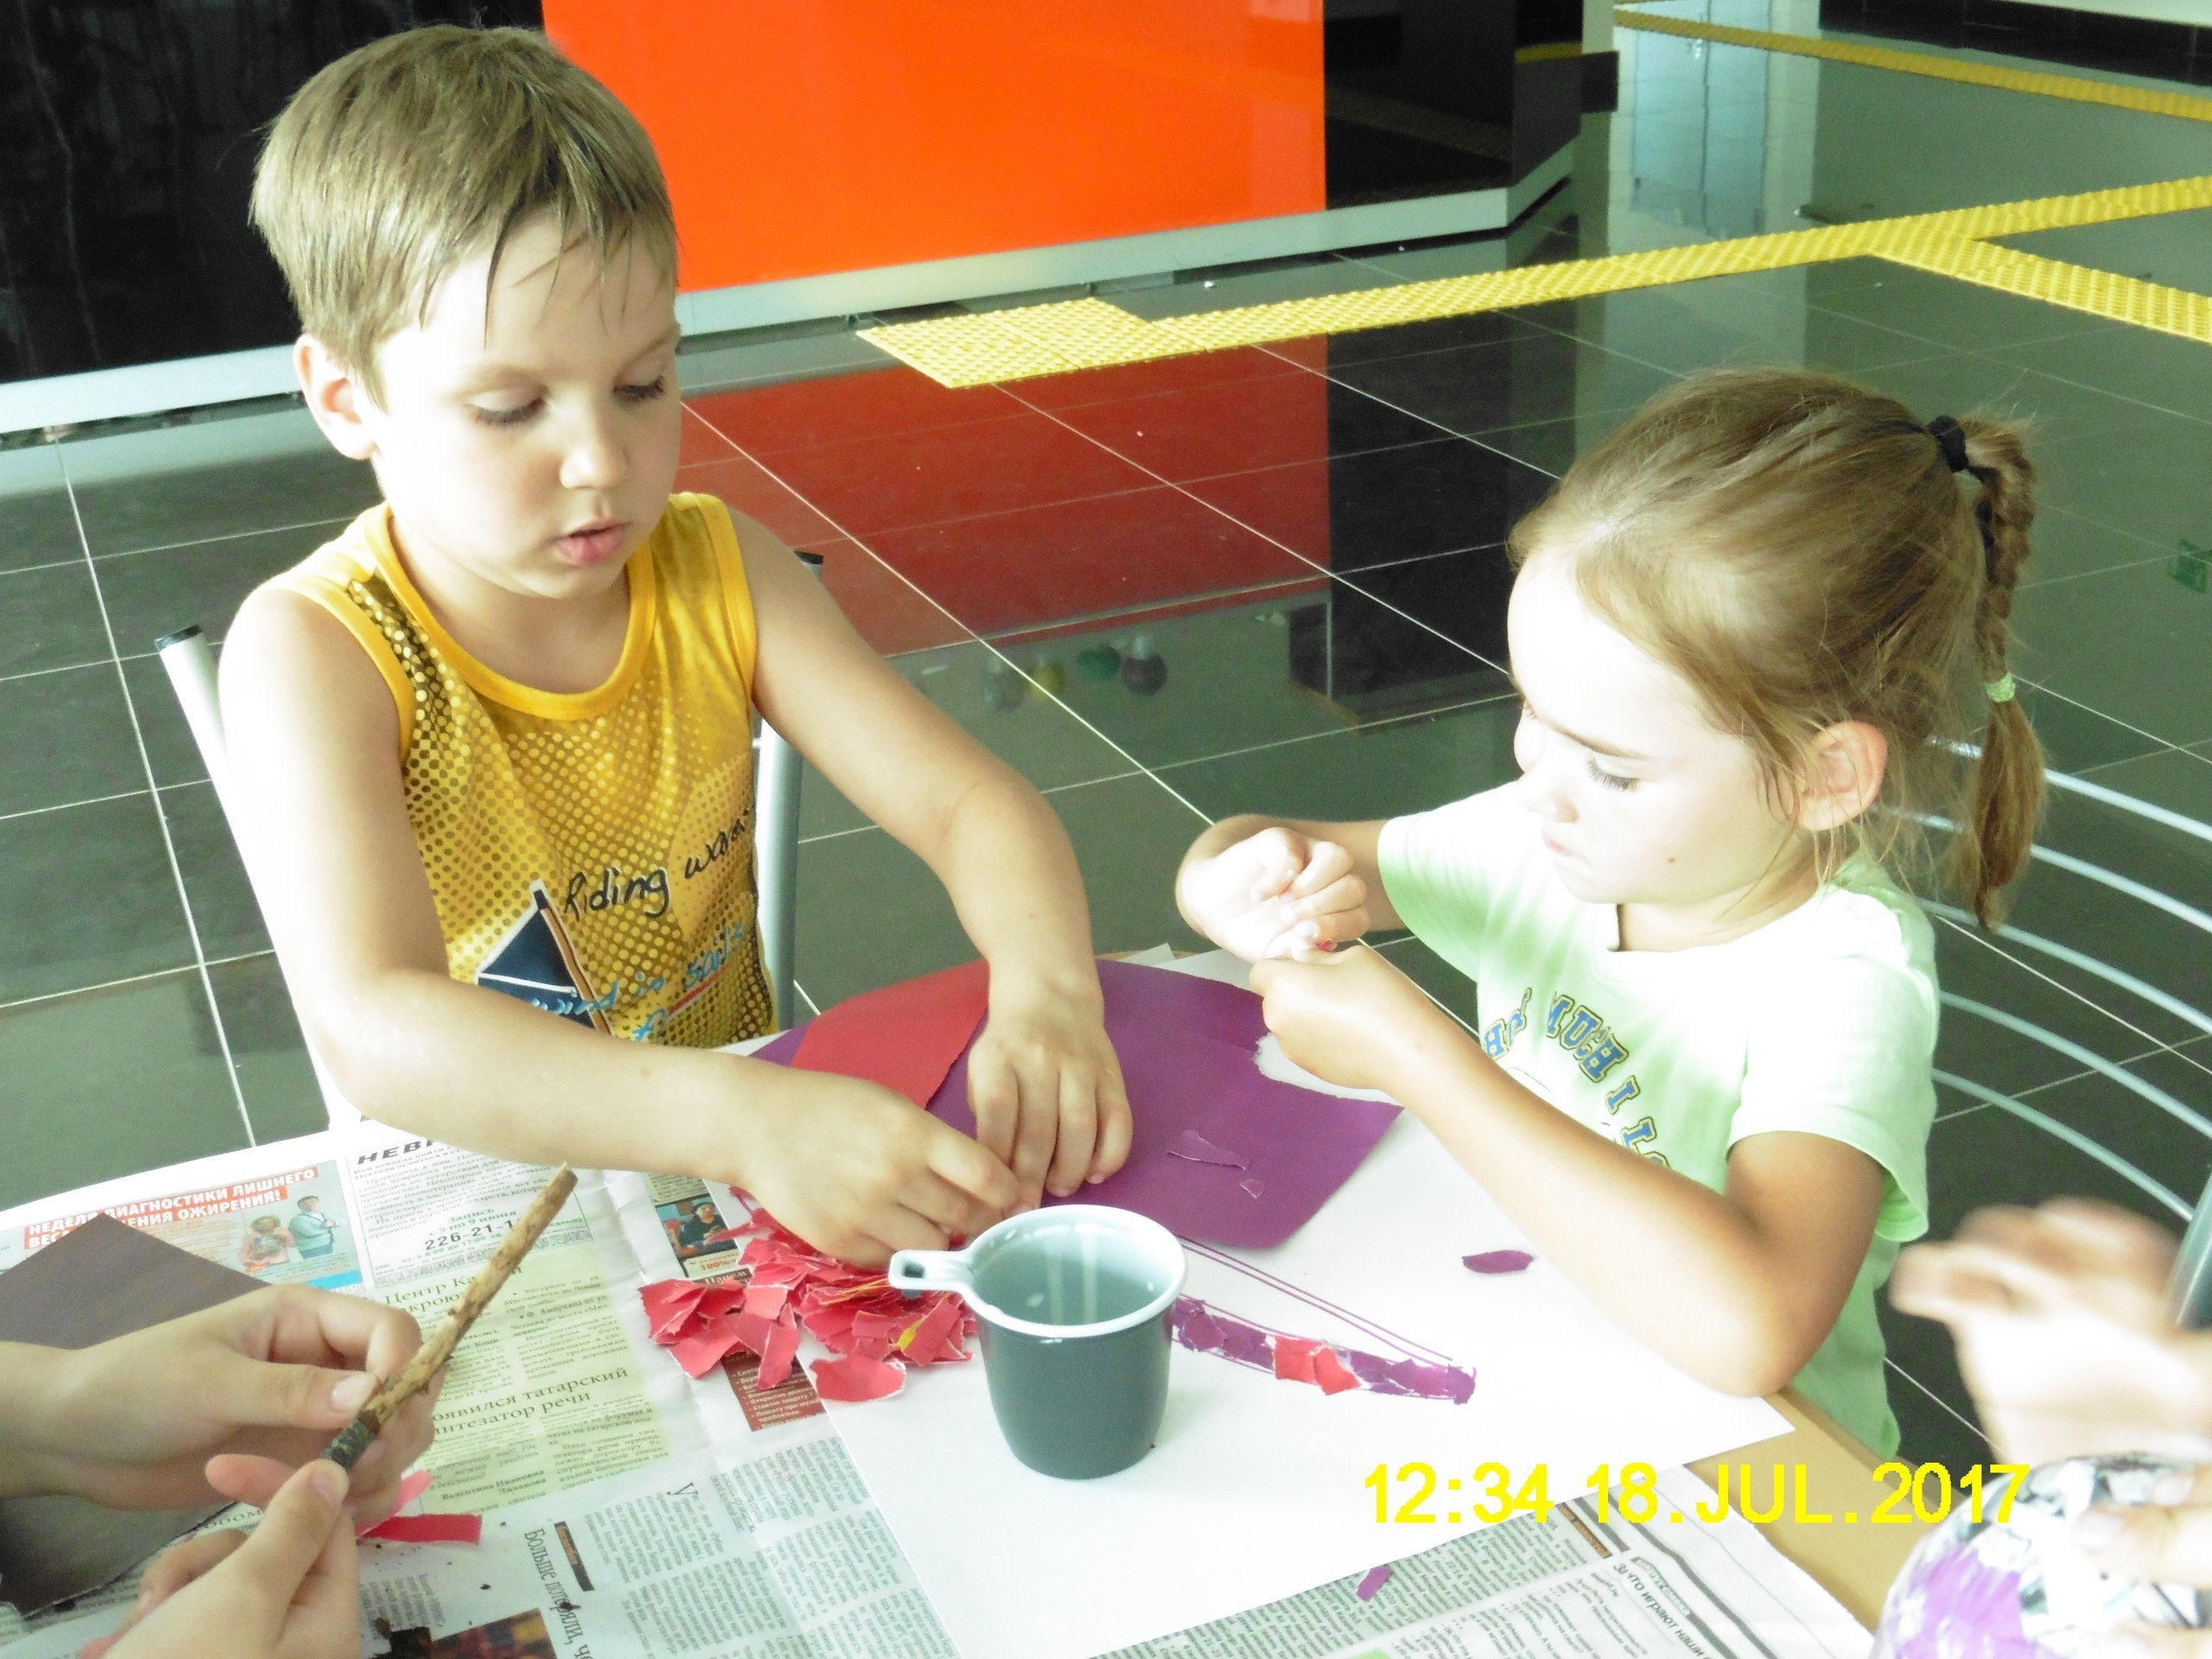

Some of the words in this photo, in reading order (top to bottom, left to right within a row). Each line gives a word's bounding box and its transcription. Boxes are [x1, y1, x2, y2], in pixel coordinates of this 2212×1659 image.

[563, 866, 669, 921] Riding
[233, 1168, 315, 1198] ЛИШНЕГО
[177, 1190, 282, 1220] ОЖИРЕНИЯ!
[425, 1217, 521, 1250] 226-21-1
[385, 1282, 447, 1306] Центр
[432, 1395, 517, 1421] оявился
[523, 1367, 629, 1400] татарский
[435, 1406, 536, 1434] нтезатор
[541, 1391, 591, 1414] речи
[524, 1527, 557, 1580] Больше
[1627, 1573, 1646, 1591] что
[1642, 1591, 1678, 1630] играют
[1675, 1627, 1706, 1657] наши
